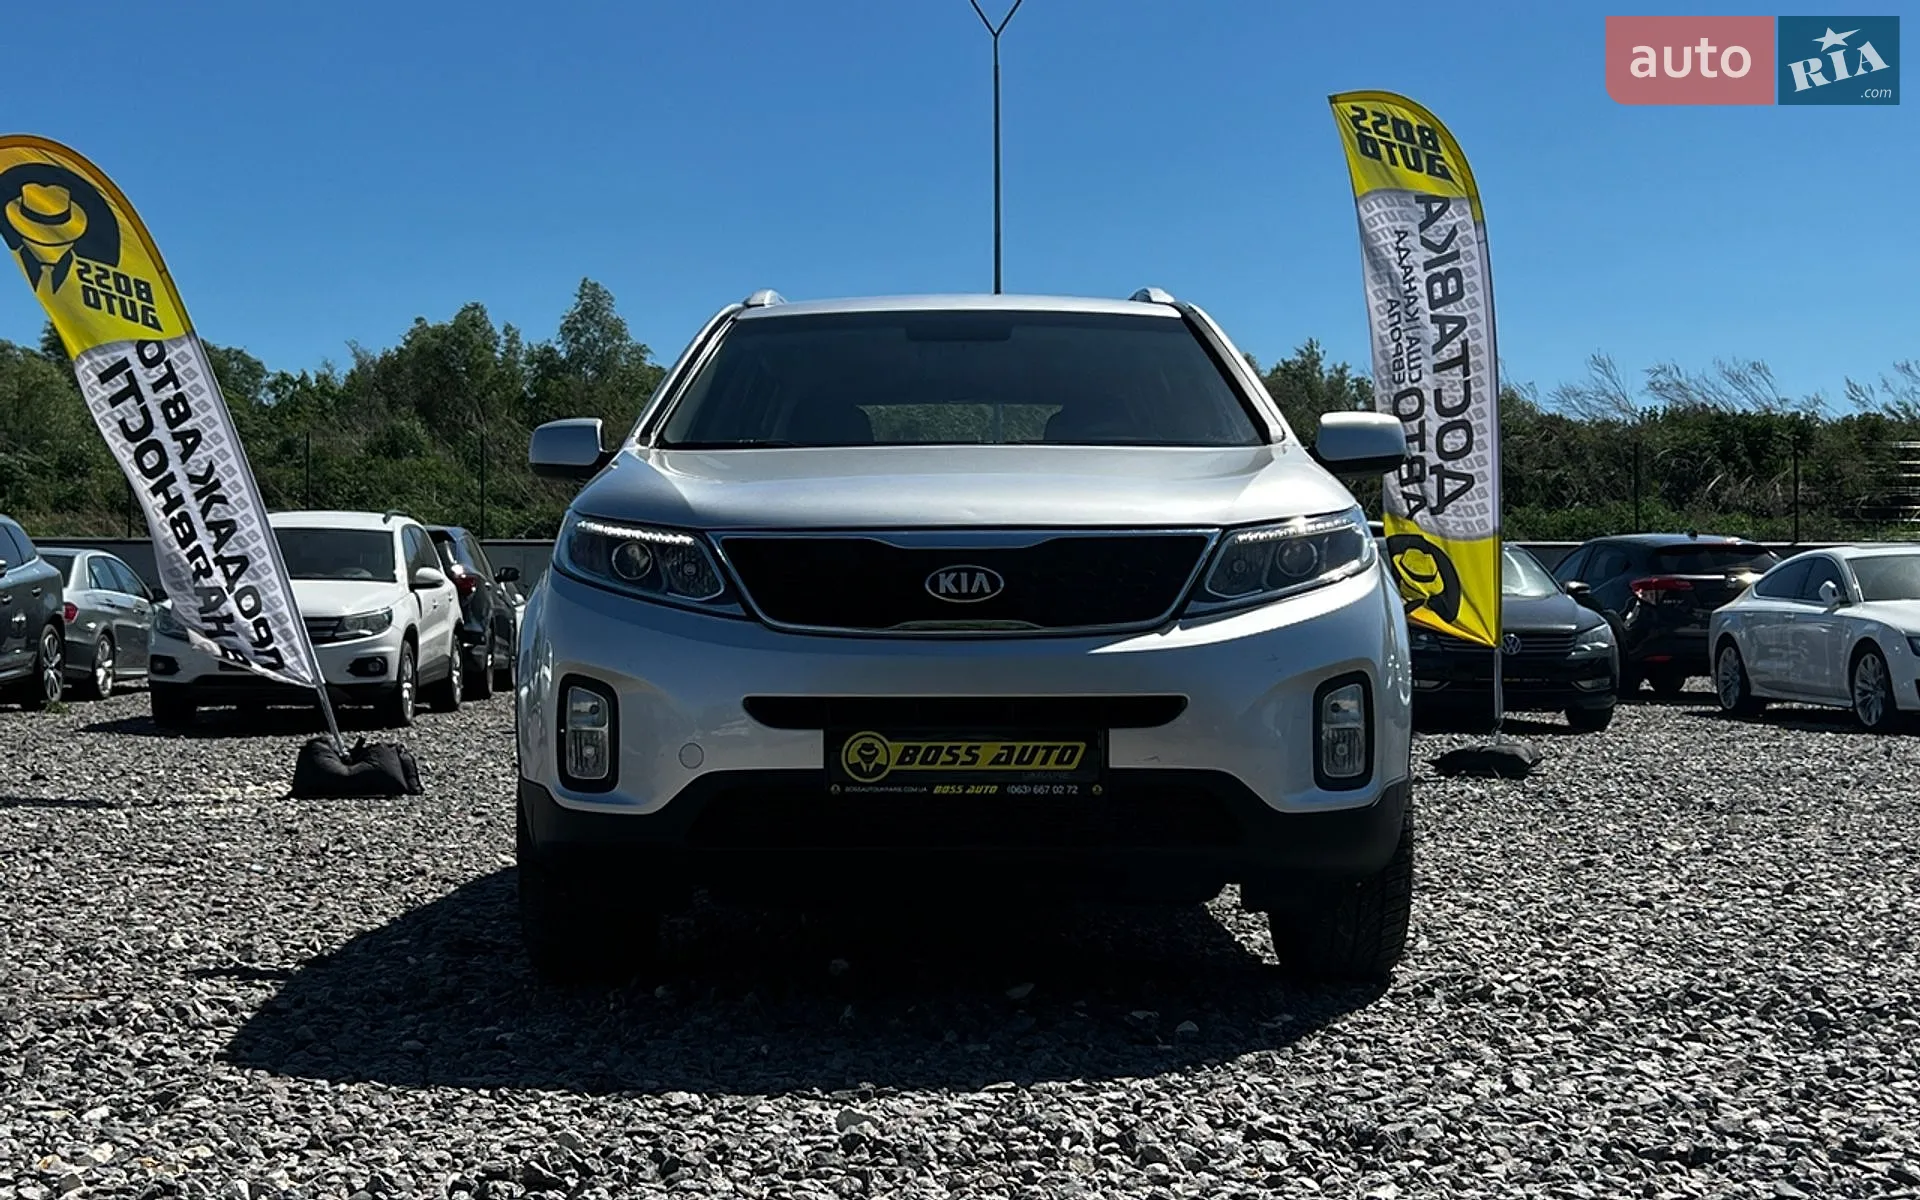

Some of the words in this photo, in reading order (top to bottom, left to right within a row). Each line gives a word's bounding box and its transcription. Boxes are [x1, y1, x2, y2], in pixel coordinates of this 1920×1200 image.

[939, 572, 991, 593] KIA
[896, 745, 982, 766] BOSS
[988, 745, 1081, 766] AUTO
[933, 784, 964, 794] BOSS
